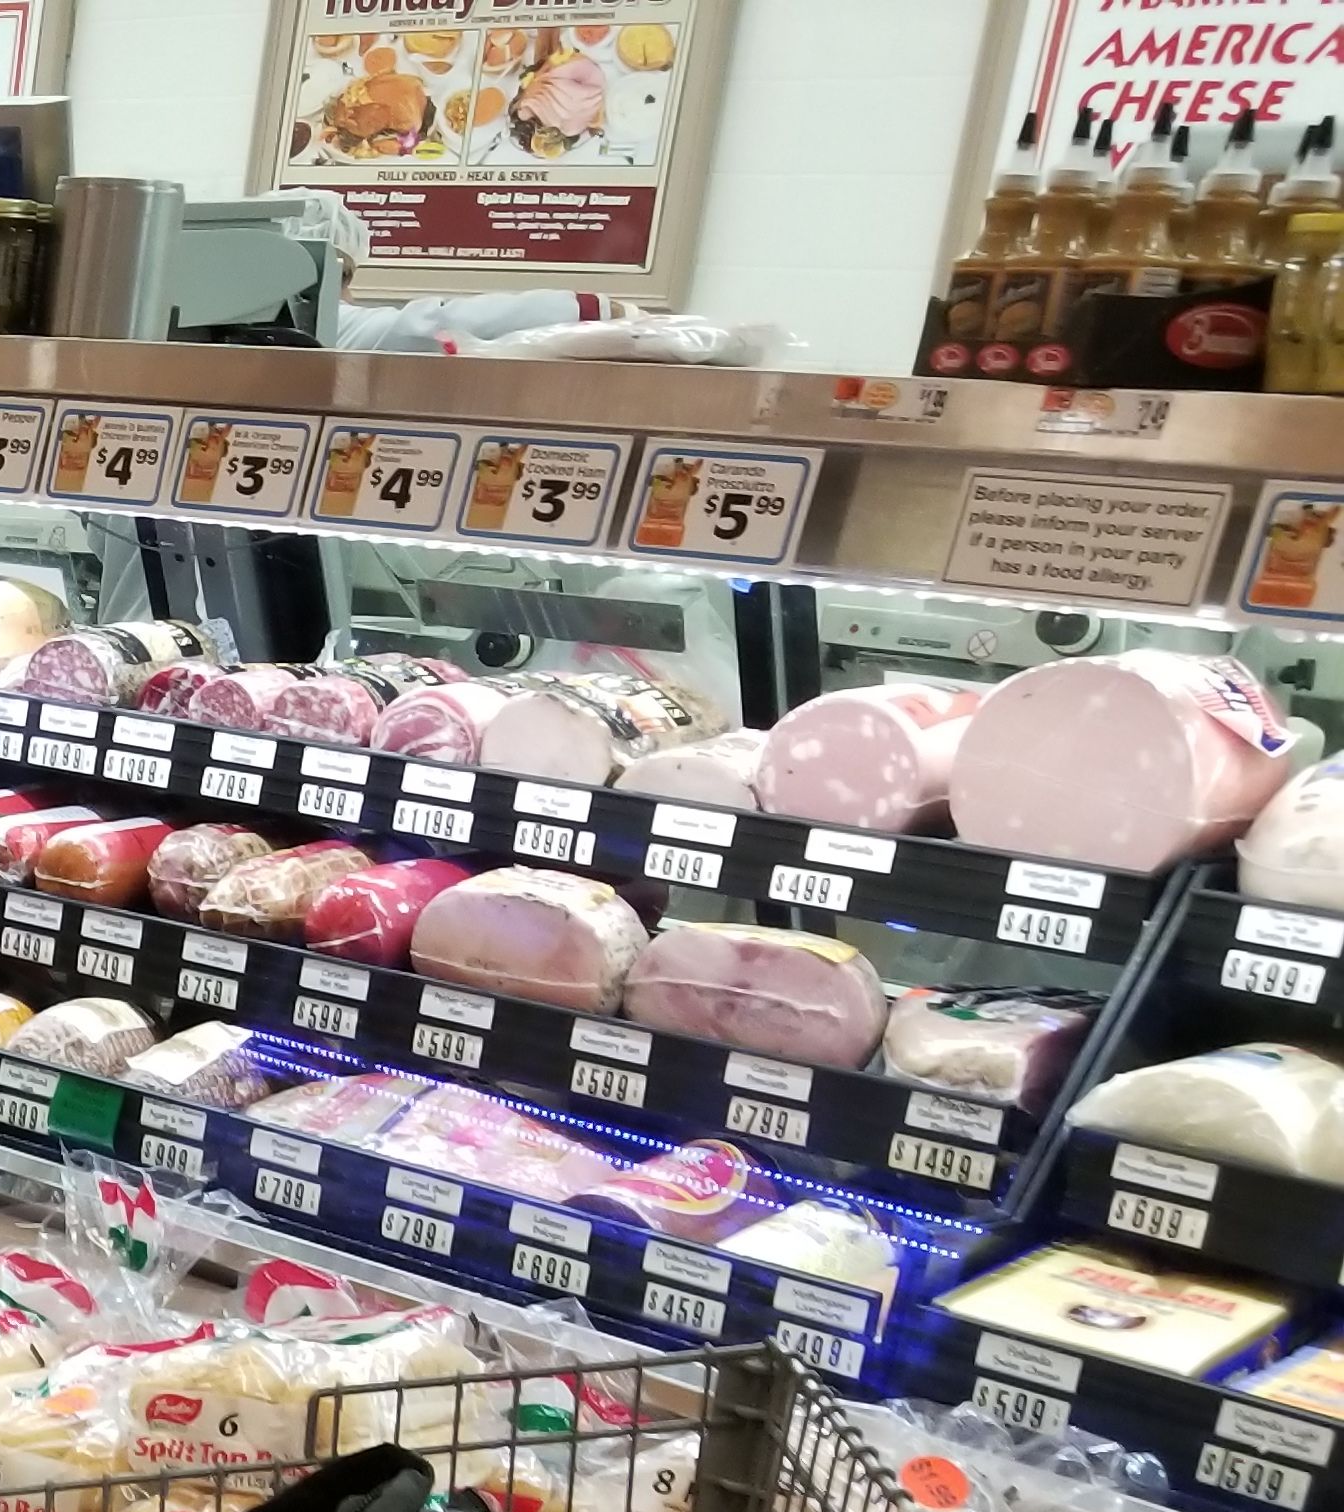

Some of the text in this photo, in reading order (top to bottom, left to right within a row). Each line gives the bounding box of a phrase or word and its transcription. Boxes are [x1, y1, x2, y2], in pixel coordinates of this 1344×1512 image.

[1079, 80, 1295, 122] CHEESE
[377, 171, 548, 182] FULLY COOKED HEAT & SERVE
[531, 448, 590, 464] Domestic
[526, 462, 607, 478] Cooked Ham
[973, 485, 1152, 515] Before placing your
[968, 510, 1204, 543] please inform your server
[1000, 537, 1063, 555] person
[1068, 541, 1085, 556] in
[1089, 546, 1134, 562] your
[1137, 550, 1187, 571] party
[991, 557, 1022, 575] has
[1043, 562, 1085, 581] food
[219, 1412, 240, 1437] 6
[135, 1437, 195, 1463] Split
[653, 1469, 676, 1495] 8
